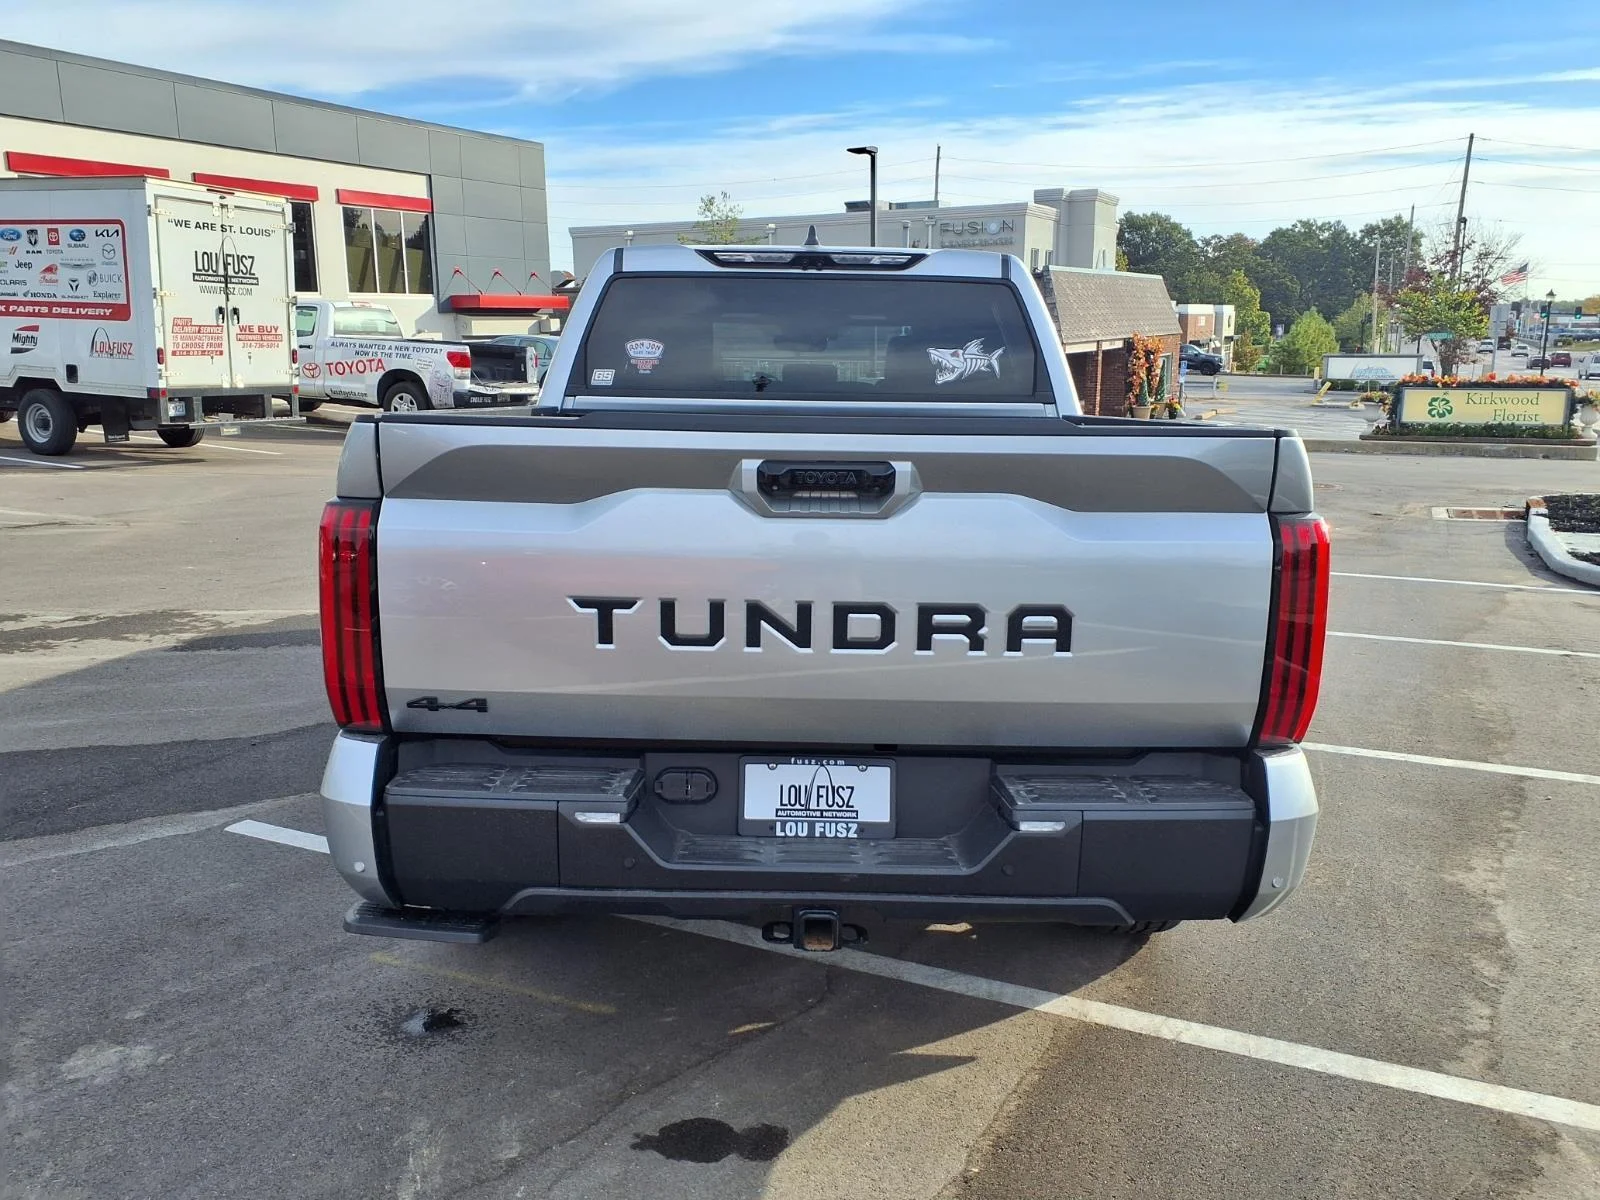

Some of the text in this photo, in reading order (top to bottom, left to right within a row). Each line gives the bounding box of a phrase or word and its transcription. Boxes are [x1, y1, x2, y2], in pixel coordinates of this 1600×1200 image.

[195, 221, 217, 231] ARE
[220, 224, 236, 233] ST.
[940, 220, 1014, 234] FUSION
[15, 259, 33, 270] Jeep
[195, 250, 256, 276] LOU FUSZ
[100, 273, 123, 284] BUICK
[9, 305, 49, 313] PARTS
[52, 306, 112, 316] DELIVERY
[238, 325, 279, 334] WE BUY
[12, 333, 38, 346] Mighty
[628, 341, 661, 351] RON JON
[95, 340, 133, 355] LOU FUSZ
[330, 341, 357, 349] ALWAYS
[358, 343, 386, 351] WANTED
[412, 346, 443, 355] TOYOTA?
[325, 358, 386, 377] TOYOTA
[1466, 391, 1540, 407] Kirkwood
[1492, 408, 1541, 423] Florist
[794, 471, 857, 485] TOYOTA
[565, 596, 1076, 657] TUNDRA
[791, 757, 845, 766] fusz.com
[780, 784, 855, 809] LOU FUSZ
[777, 809, 821, 818] AUTOMOTIVE
[775, 821, 858, 838] LOU FUSZ
